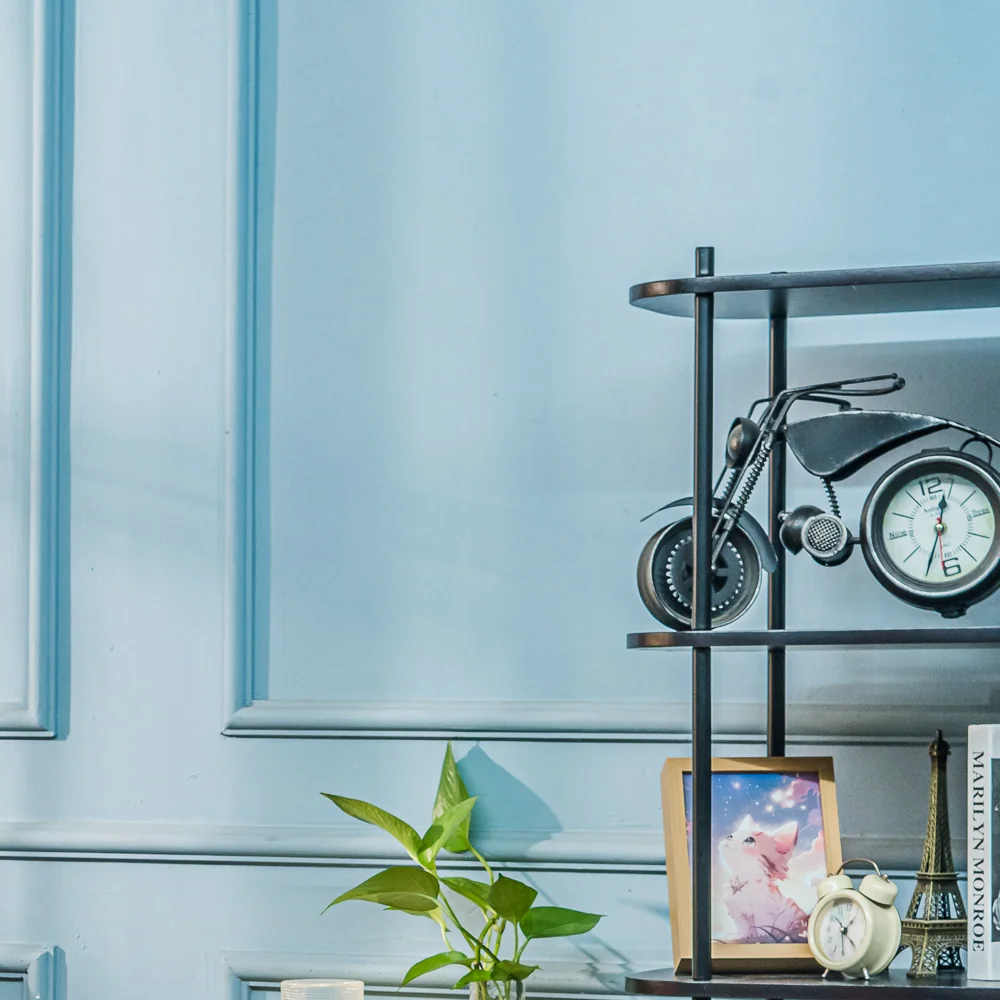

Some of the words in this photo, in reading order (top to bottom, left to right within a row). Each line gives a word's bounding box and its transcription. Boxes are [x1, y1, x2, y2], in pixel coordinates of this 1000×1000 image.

[919, 476, 943, 496] 12
[941, 557, 962, 577] 6
[972, 750, 985, 850] MARILYN
[972, 857, 985, 952] MONROE
